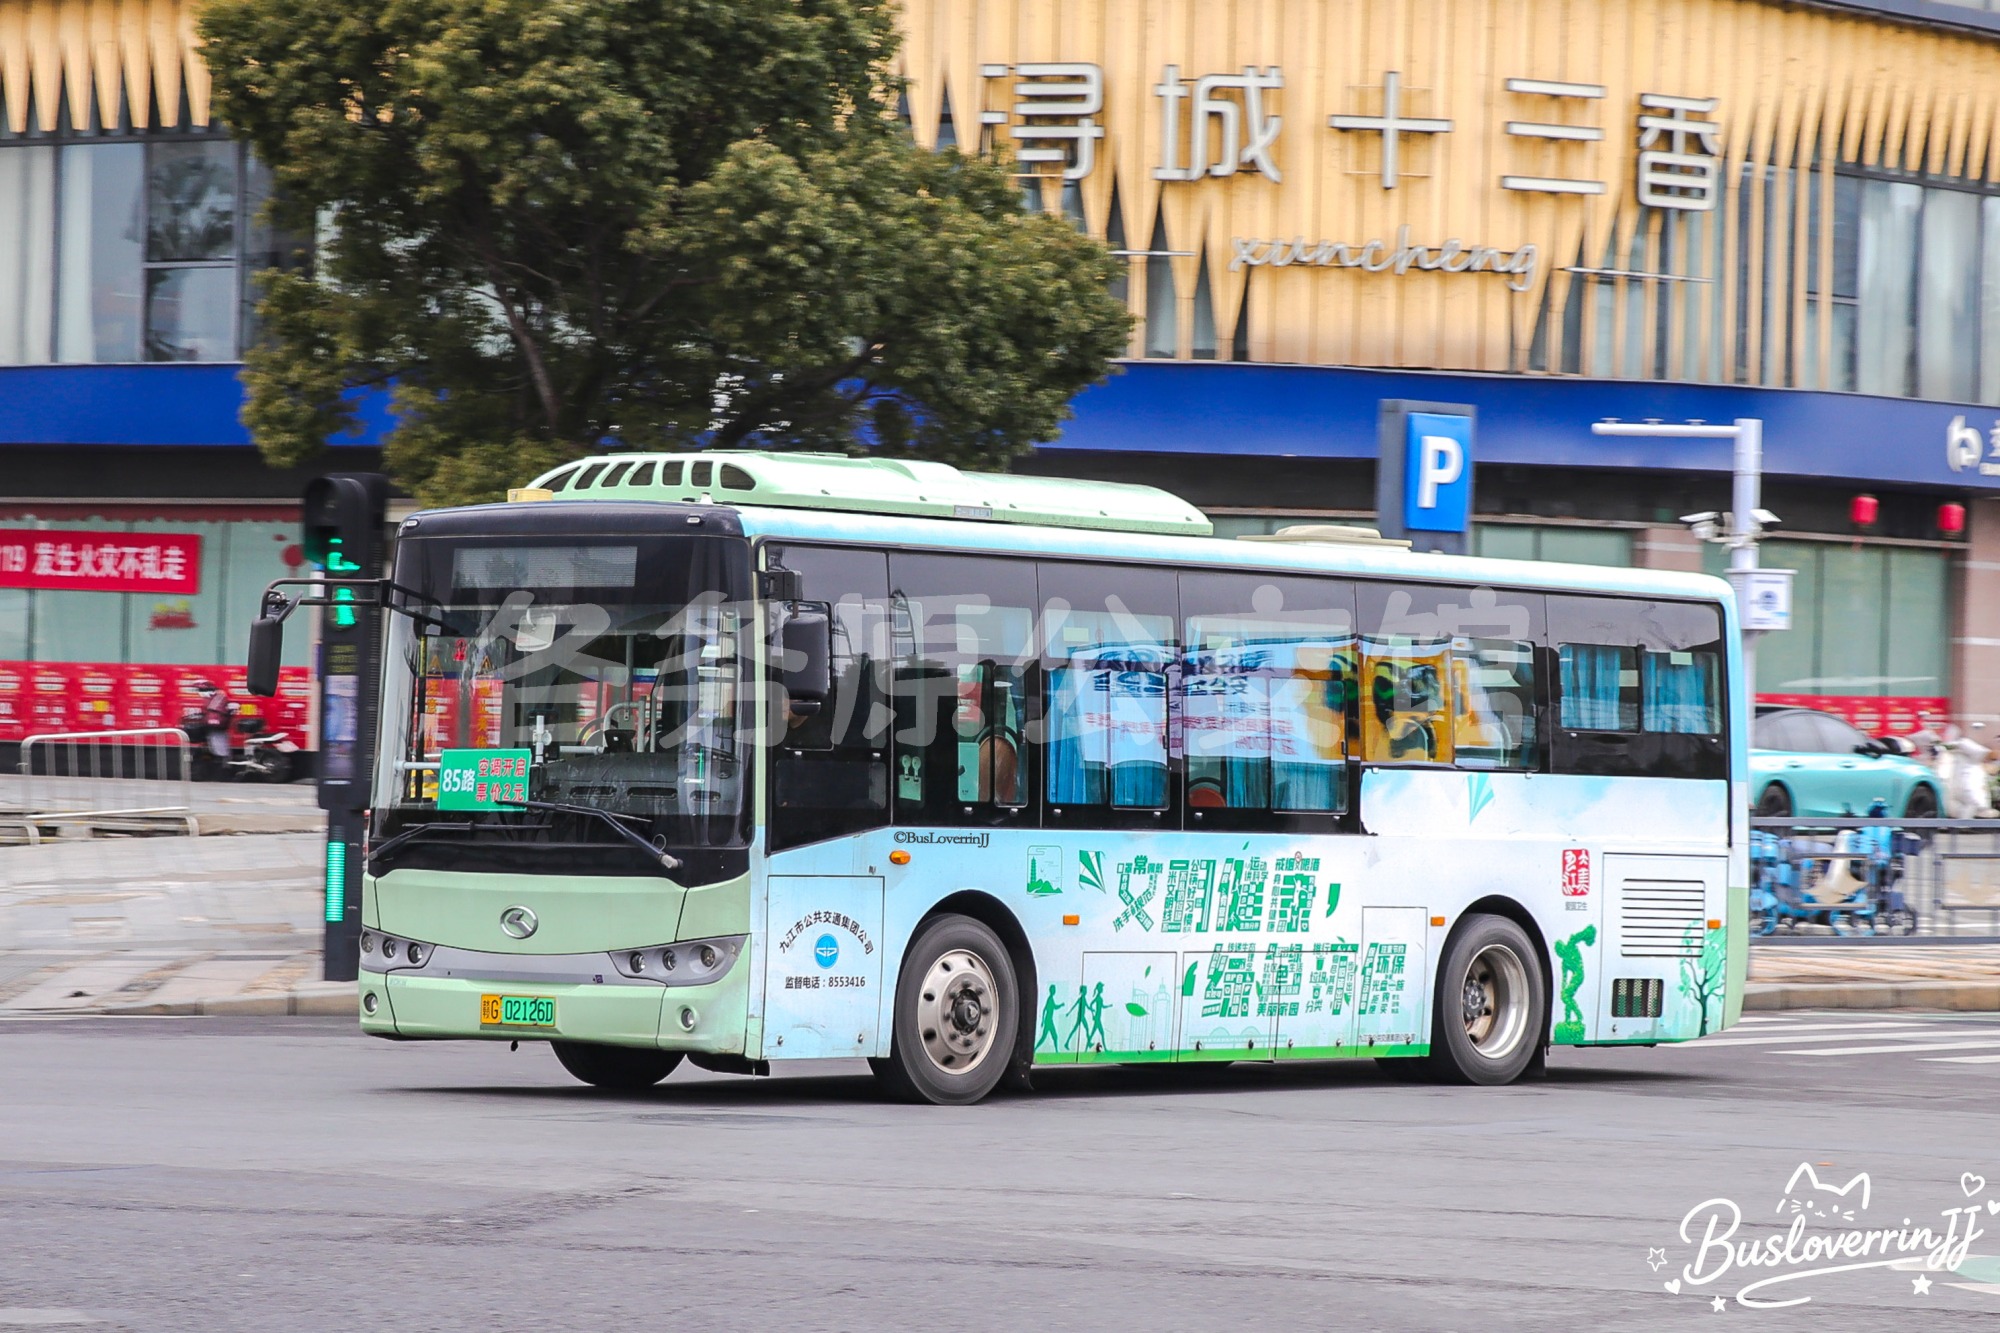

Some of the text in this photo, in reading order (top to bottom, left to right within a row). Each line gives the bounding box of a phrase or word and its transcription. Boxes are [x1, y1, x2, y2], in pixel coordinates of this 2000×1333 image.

[979, 62, 1720, 211] 浔城十三香
[1228, 223, 1538, 292] xuncheng
[1417, 435, 1464, 508] P
[0, 545, 27, 572] 19
[442, 769, 476, 793] 85路
[478, 758, 526, 777] 空调开启
[475, 783, 524, 802] 票价2元
[779, 910, 874, 955] 九江市公共交通集团公司
